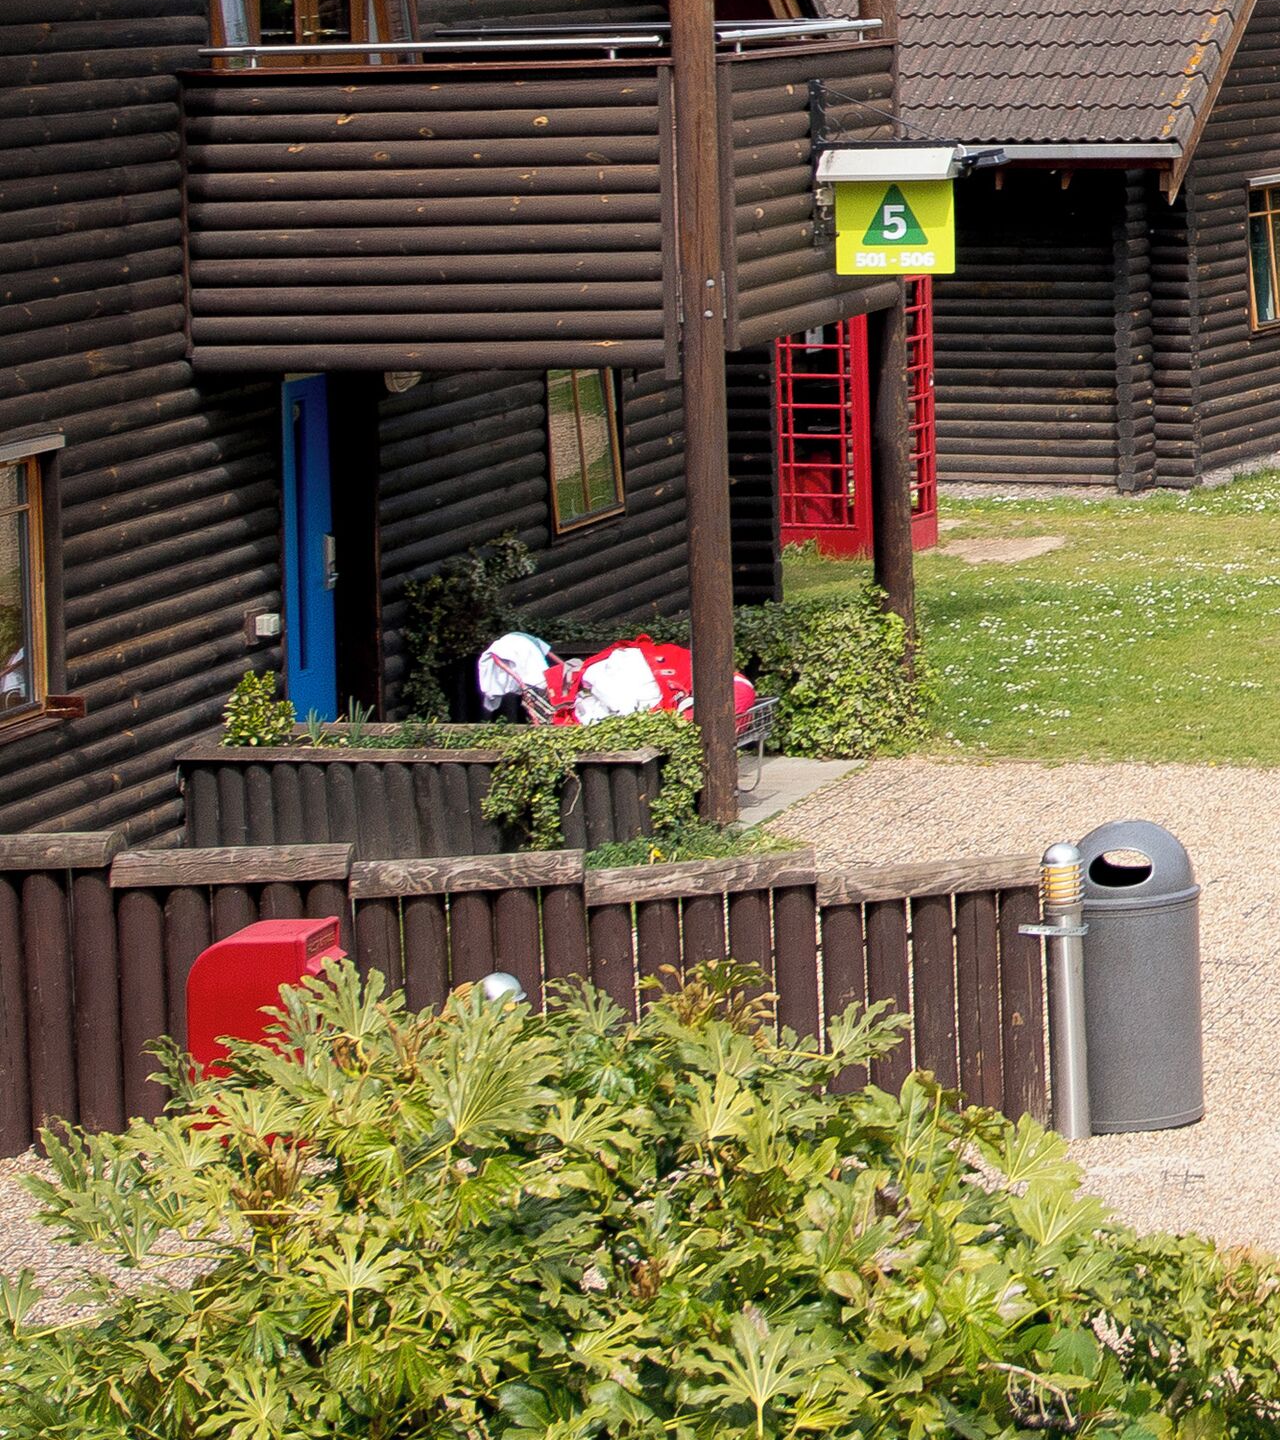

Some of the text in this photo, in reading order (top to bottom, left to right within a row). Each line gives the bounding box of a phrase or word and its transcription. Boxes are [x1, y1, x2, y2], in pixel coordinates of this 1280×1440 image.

[882, 204, 908, 240] 5
[855, 252, 887, 268] 501
[900, 251, 935, 267] 506
